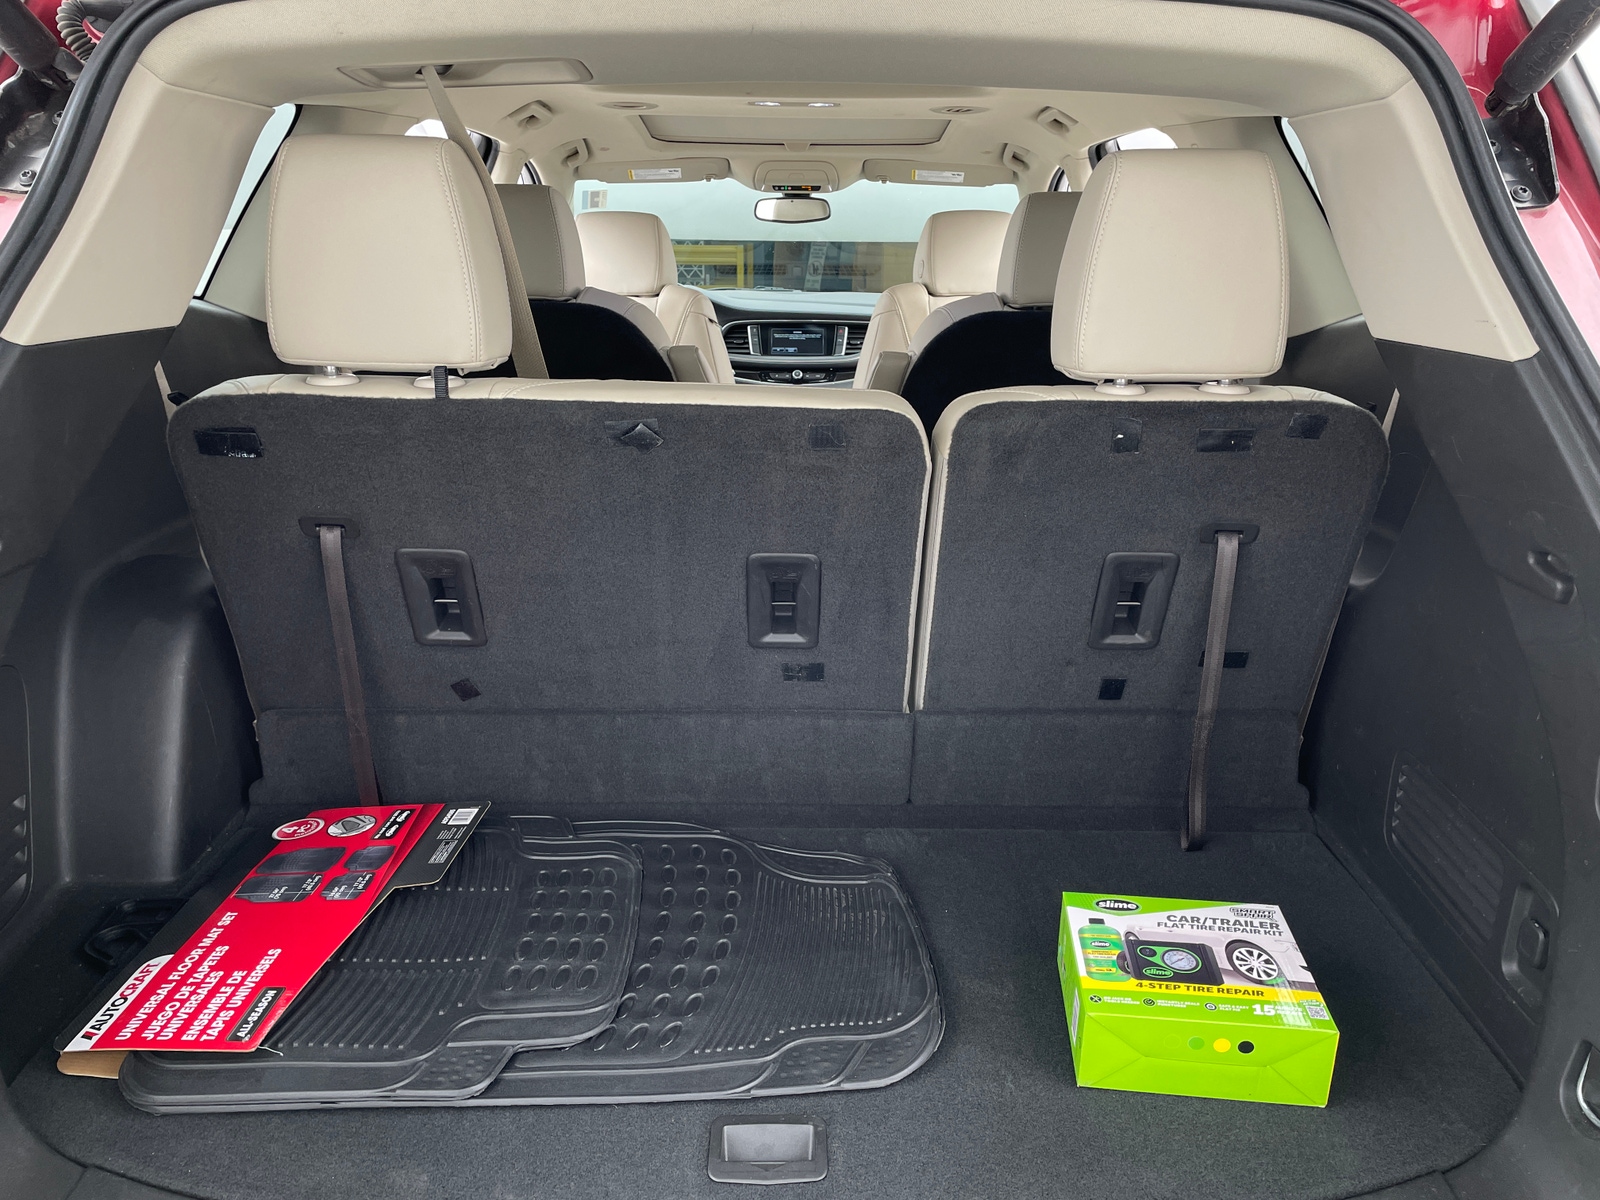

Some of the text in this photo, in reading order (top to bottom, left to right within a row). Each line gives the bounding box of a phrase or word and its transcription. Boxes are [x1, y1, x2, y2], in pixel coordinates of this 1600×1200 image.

[1098, 899, 1137, 910] slime
[1157, 921, 1186, 929] FLAT
[1188, 923, 1215, 931] TIRE
[1218, 925, 1261, 935] REPAIR
[1166, 914, 1280, 930] CAR/TRAILER
[115, 911, 238, 1040] UNIVERSAL FLOOR MAT SET
[141, 945, 229, 1040] JUEGO DE TAPETES
[200, 948, 282, 1041] TAPIS UNIVERSELS
[1136, 982, 1265, 996] 4-STEP TIRE REPAIR
[1145, 968, 1171, 976] slime
[88, 962, 161, 1033] AUTOCRAFT
[157, 971, 224, 1040] UNIVERSALES
[181, 970, 248, 1040] ENSEMBLE DE
[237, 990, 277, 1037] ALL-SEASON
[1252, 1004, 1275, 1016] 15
